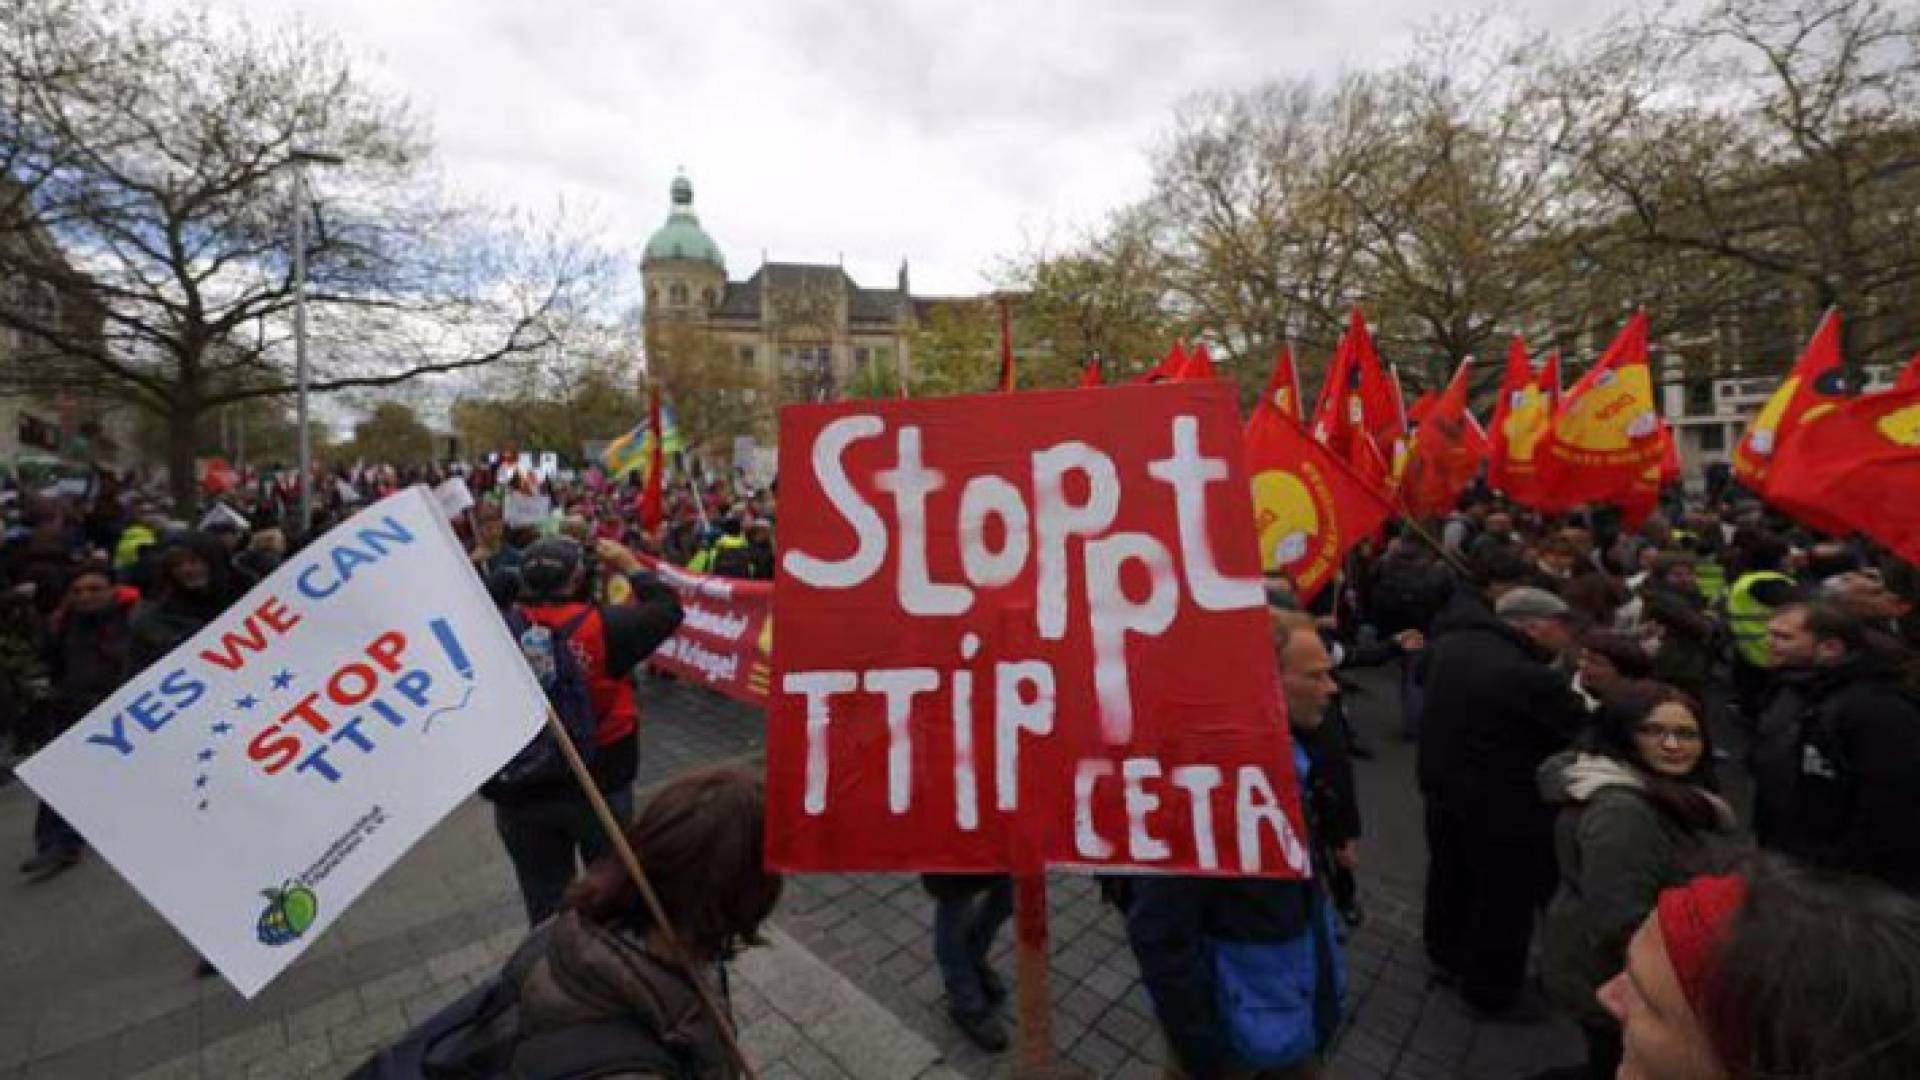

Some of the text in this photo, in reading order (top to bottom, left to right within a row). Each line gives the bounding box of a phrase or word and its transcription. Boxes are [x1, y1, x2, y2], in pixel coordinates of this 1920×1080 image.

[87, 516, 415, 756] YES WE CAN
[247, 630, 408, 775] STOP
[1074, 758, 1311, 877] CETA
